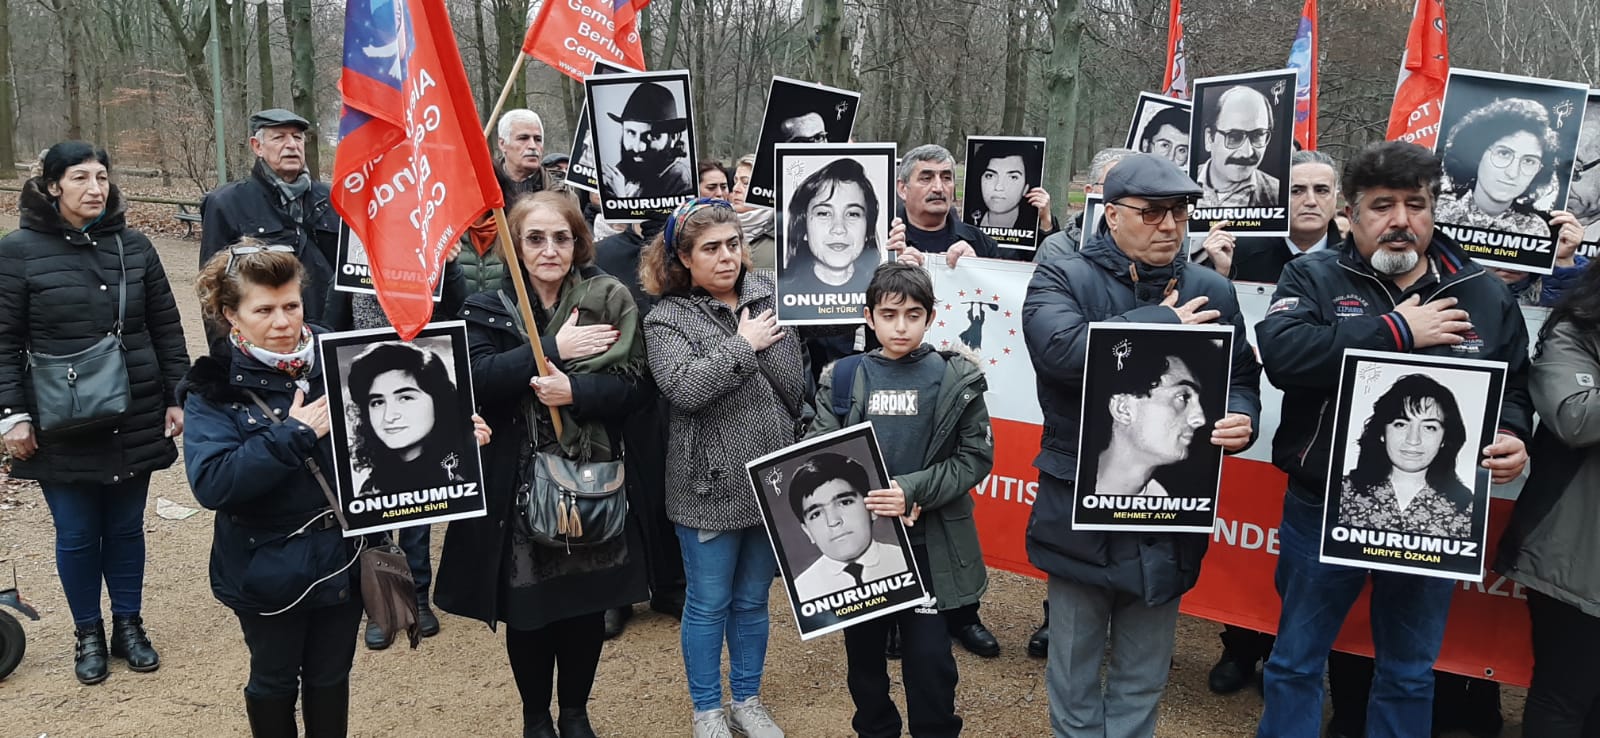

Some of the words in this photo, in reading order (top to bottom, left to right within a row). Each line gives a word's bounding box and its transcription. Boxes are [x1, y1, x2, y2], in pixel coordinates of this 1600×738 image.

[577, 21, 625, 60] Berlin
[751, 186, 775, 198] ON
[1192, 207, 1285, 220] ONURUMUZ
[979, 227, 1035, 239] URUMUZ
[1434, 225, 1552, 253] NURUMUZ
[1494, 247, 1518, 258] SİVRİ
[783, 292, 867, 306] ONURUM
[818, 305, 835, 314] İNCİ
[836, 305, 858, 313] TÜRK
[349, 482, 479, 514] ONURUMUZ
[1082, 494, 1211, 511] ONURUMUZ
[382, 506, 423, 519] ASUMAN
[424, 500, 448, 512] SİVRİ
[1113, 511, 1153, 520] MEHMET
[1154, 512, 1177, 520] ATAY
[1331, 526, 1478, 557] ONURUMUZ
[1403, 550, 1441, 563] ÖZKAN
[800, 572, 916, 617] ONURUMUZ
[835, 603, 863, 617] KORAY
[864, 596, 888, 608] KAYA
